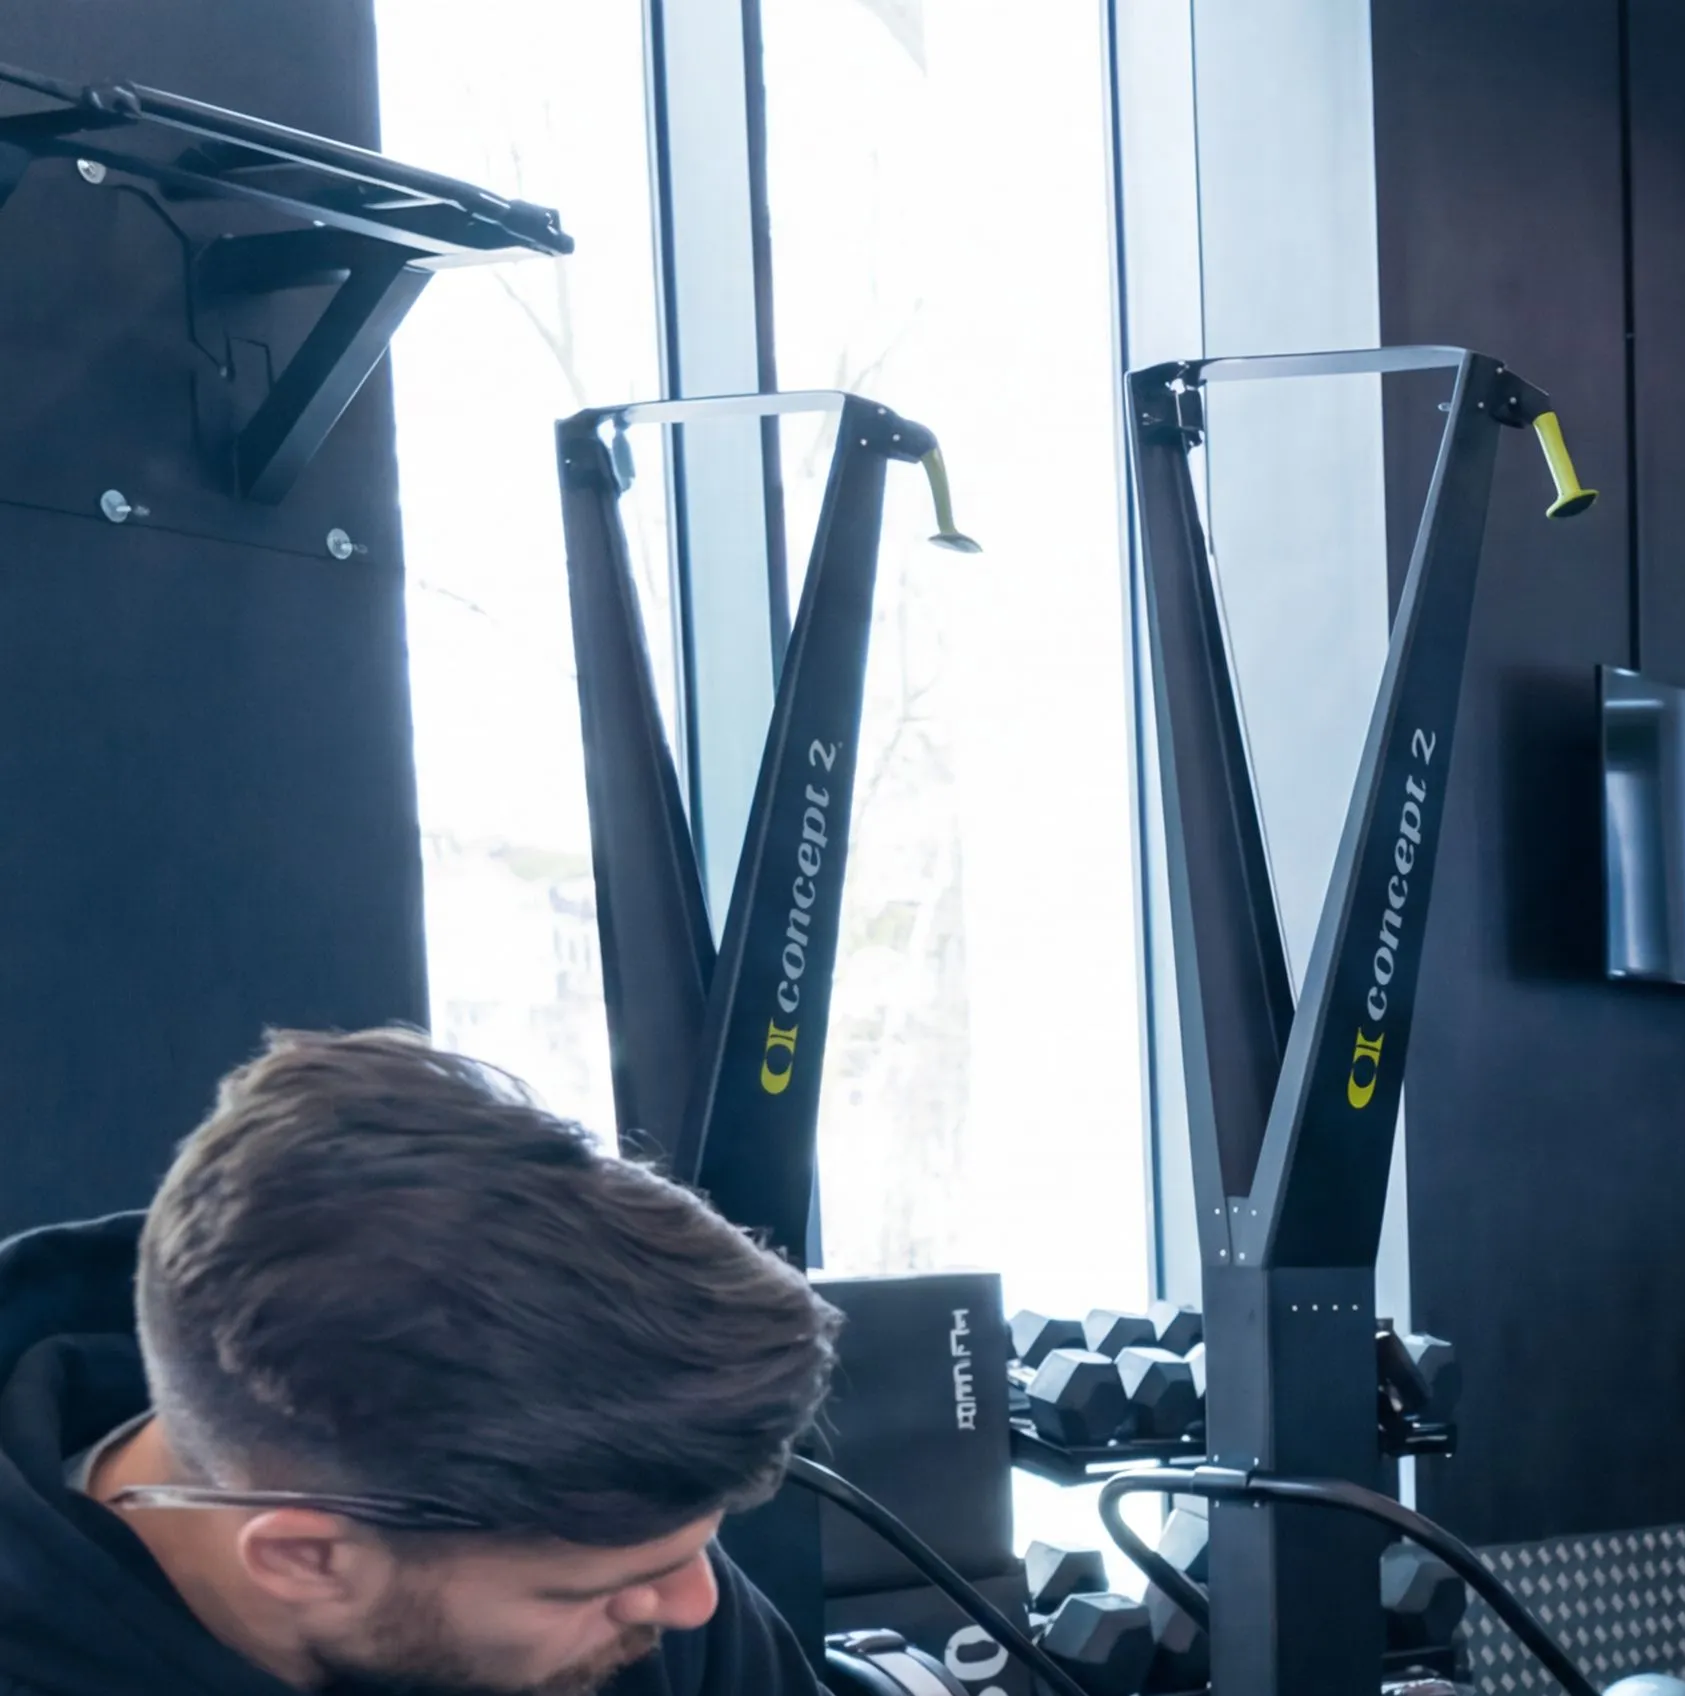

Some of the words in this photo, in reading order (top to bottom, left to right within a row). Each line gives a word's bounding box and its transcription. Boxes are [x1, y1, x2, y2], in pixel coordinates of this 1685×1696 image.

[777, 783, 831, 1014] concept
[808, 739, 836, 772] 2
[1366, 774, 1428, 1022] concept
[1411, 728, 1437, 765] 2
